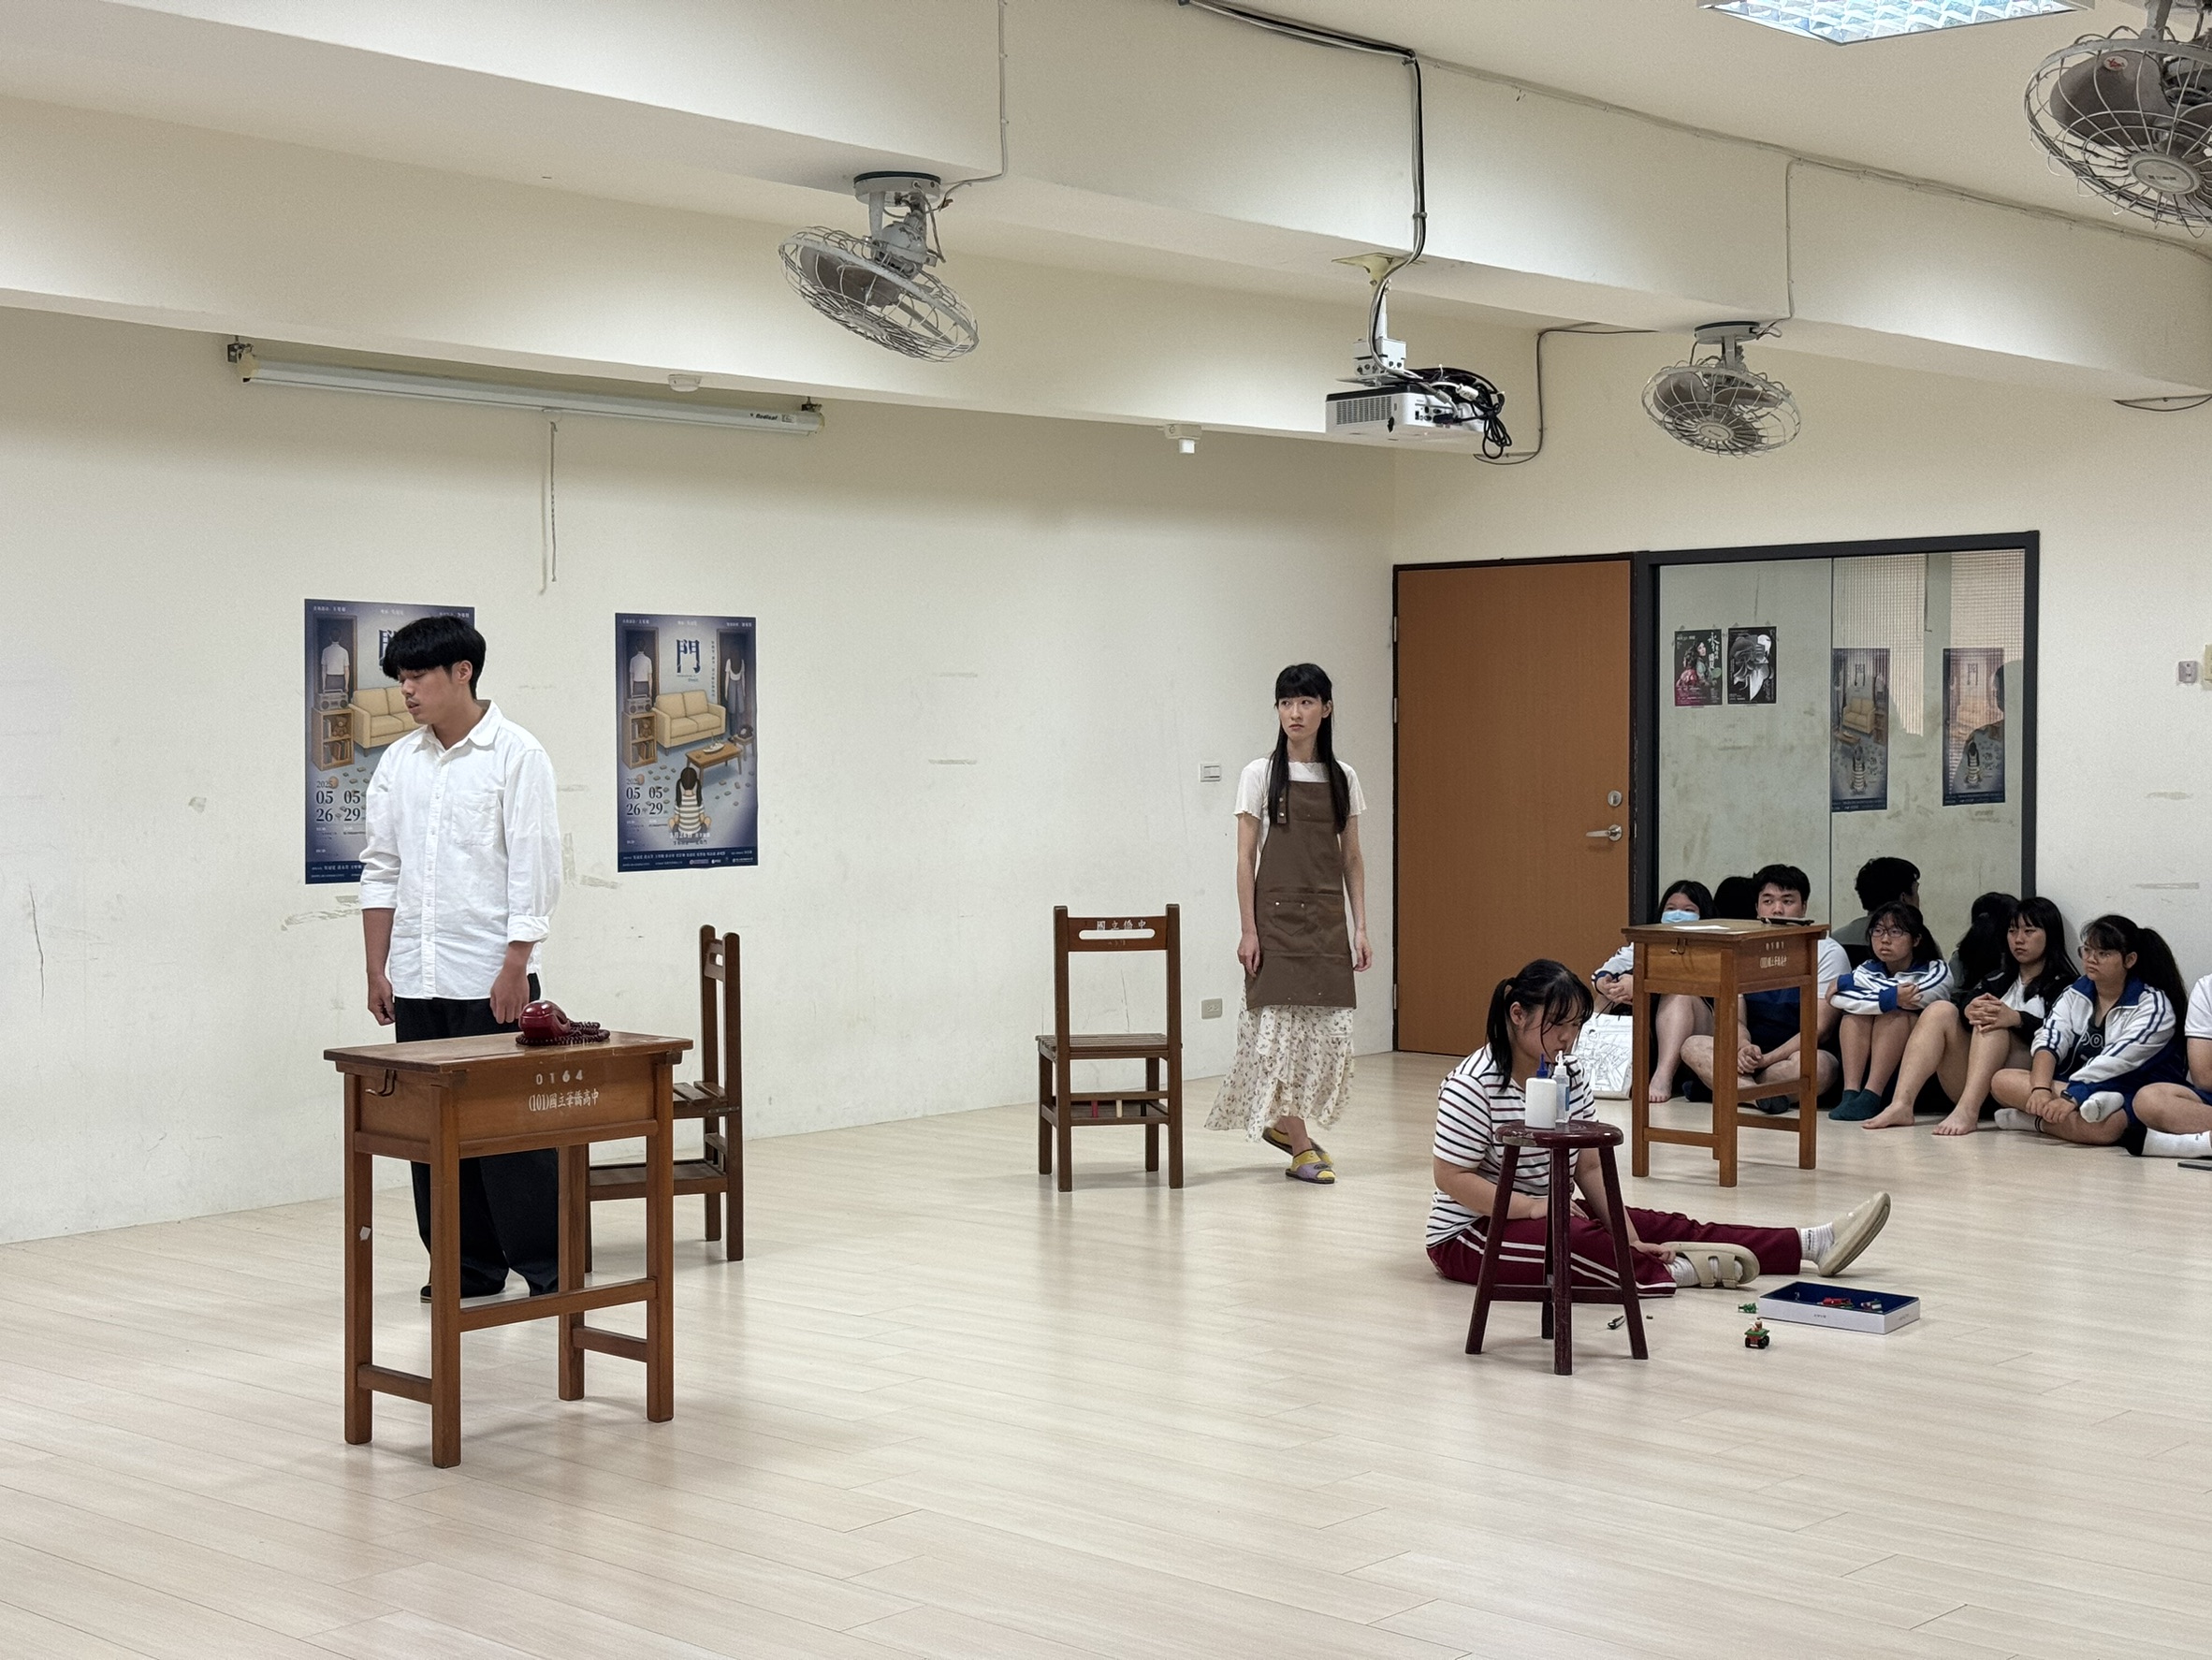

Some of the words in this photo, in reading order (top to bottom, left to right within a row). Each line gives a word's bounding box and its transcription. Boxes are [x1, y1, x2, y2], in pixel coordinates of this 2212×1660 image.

[676, 638, 702, 674] 門
[316, 790, 333, 805] 05
[343, 790, 361, 804] 05
[626, 786, 641, 799] 05
[648, 786, 662, 799] 05
[316, 808, 333, 822] 26
[343, 808, 361, 822] 29
[626, 803, 641, 816] 26
[648, 802, 663, 815] 29
[1097, 919, 1146, 931] 國立僑中
[536, 1070, 583, 1085] 0164
